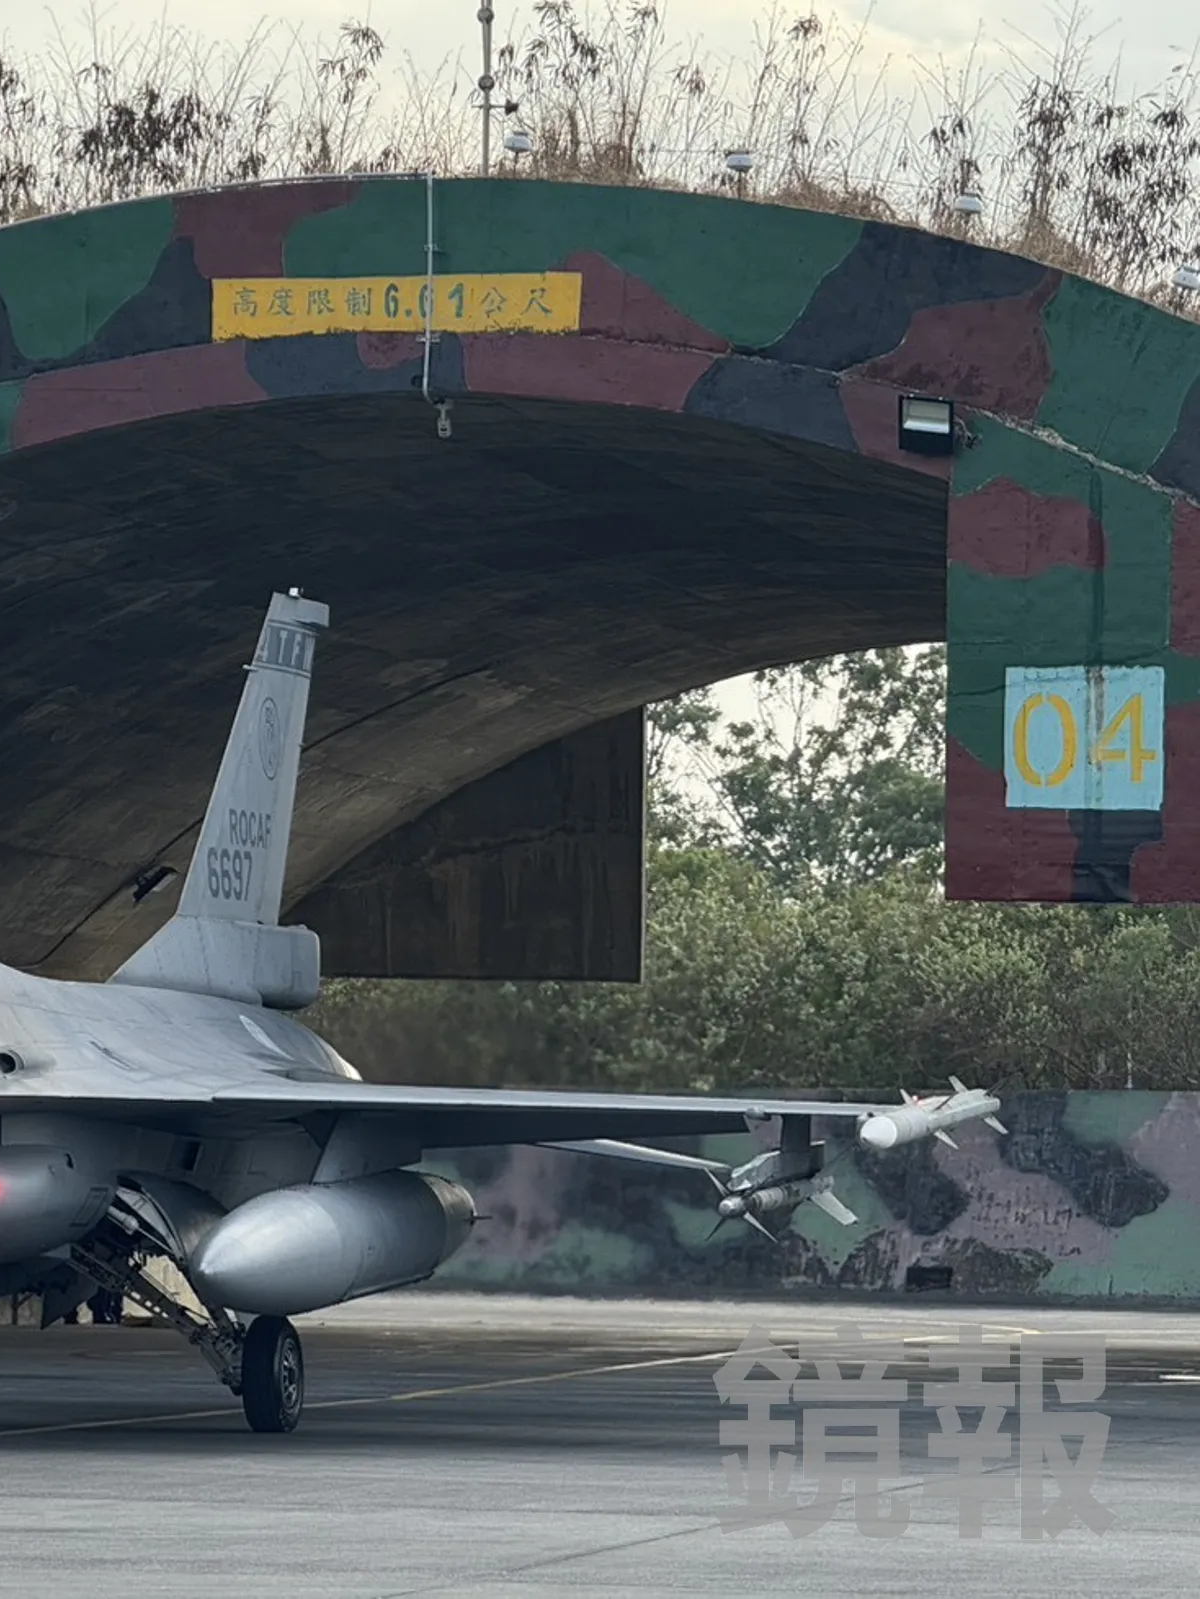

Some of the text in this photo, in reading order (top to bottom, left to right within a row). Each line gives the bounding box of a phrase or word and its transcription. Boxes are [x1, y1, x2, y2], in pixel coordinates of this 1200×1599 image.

[1013, 692, 1158, 788] 04
[229, 808, 271, 849] ROCAF
[207, 847, 252, 902] 6697
